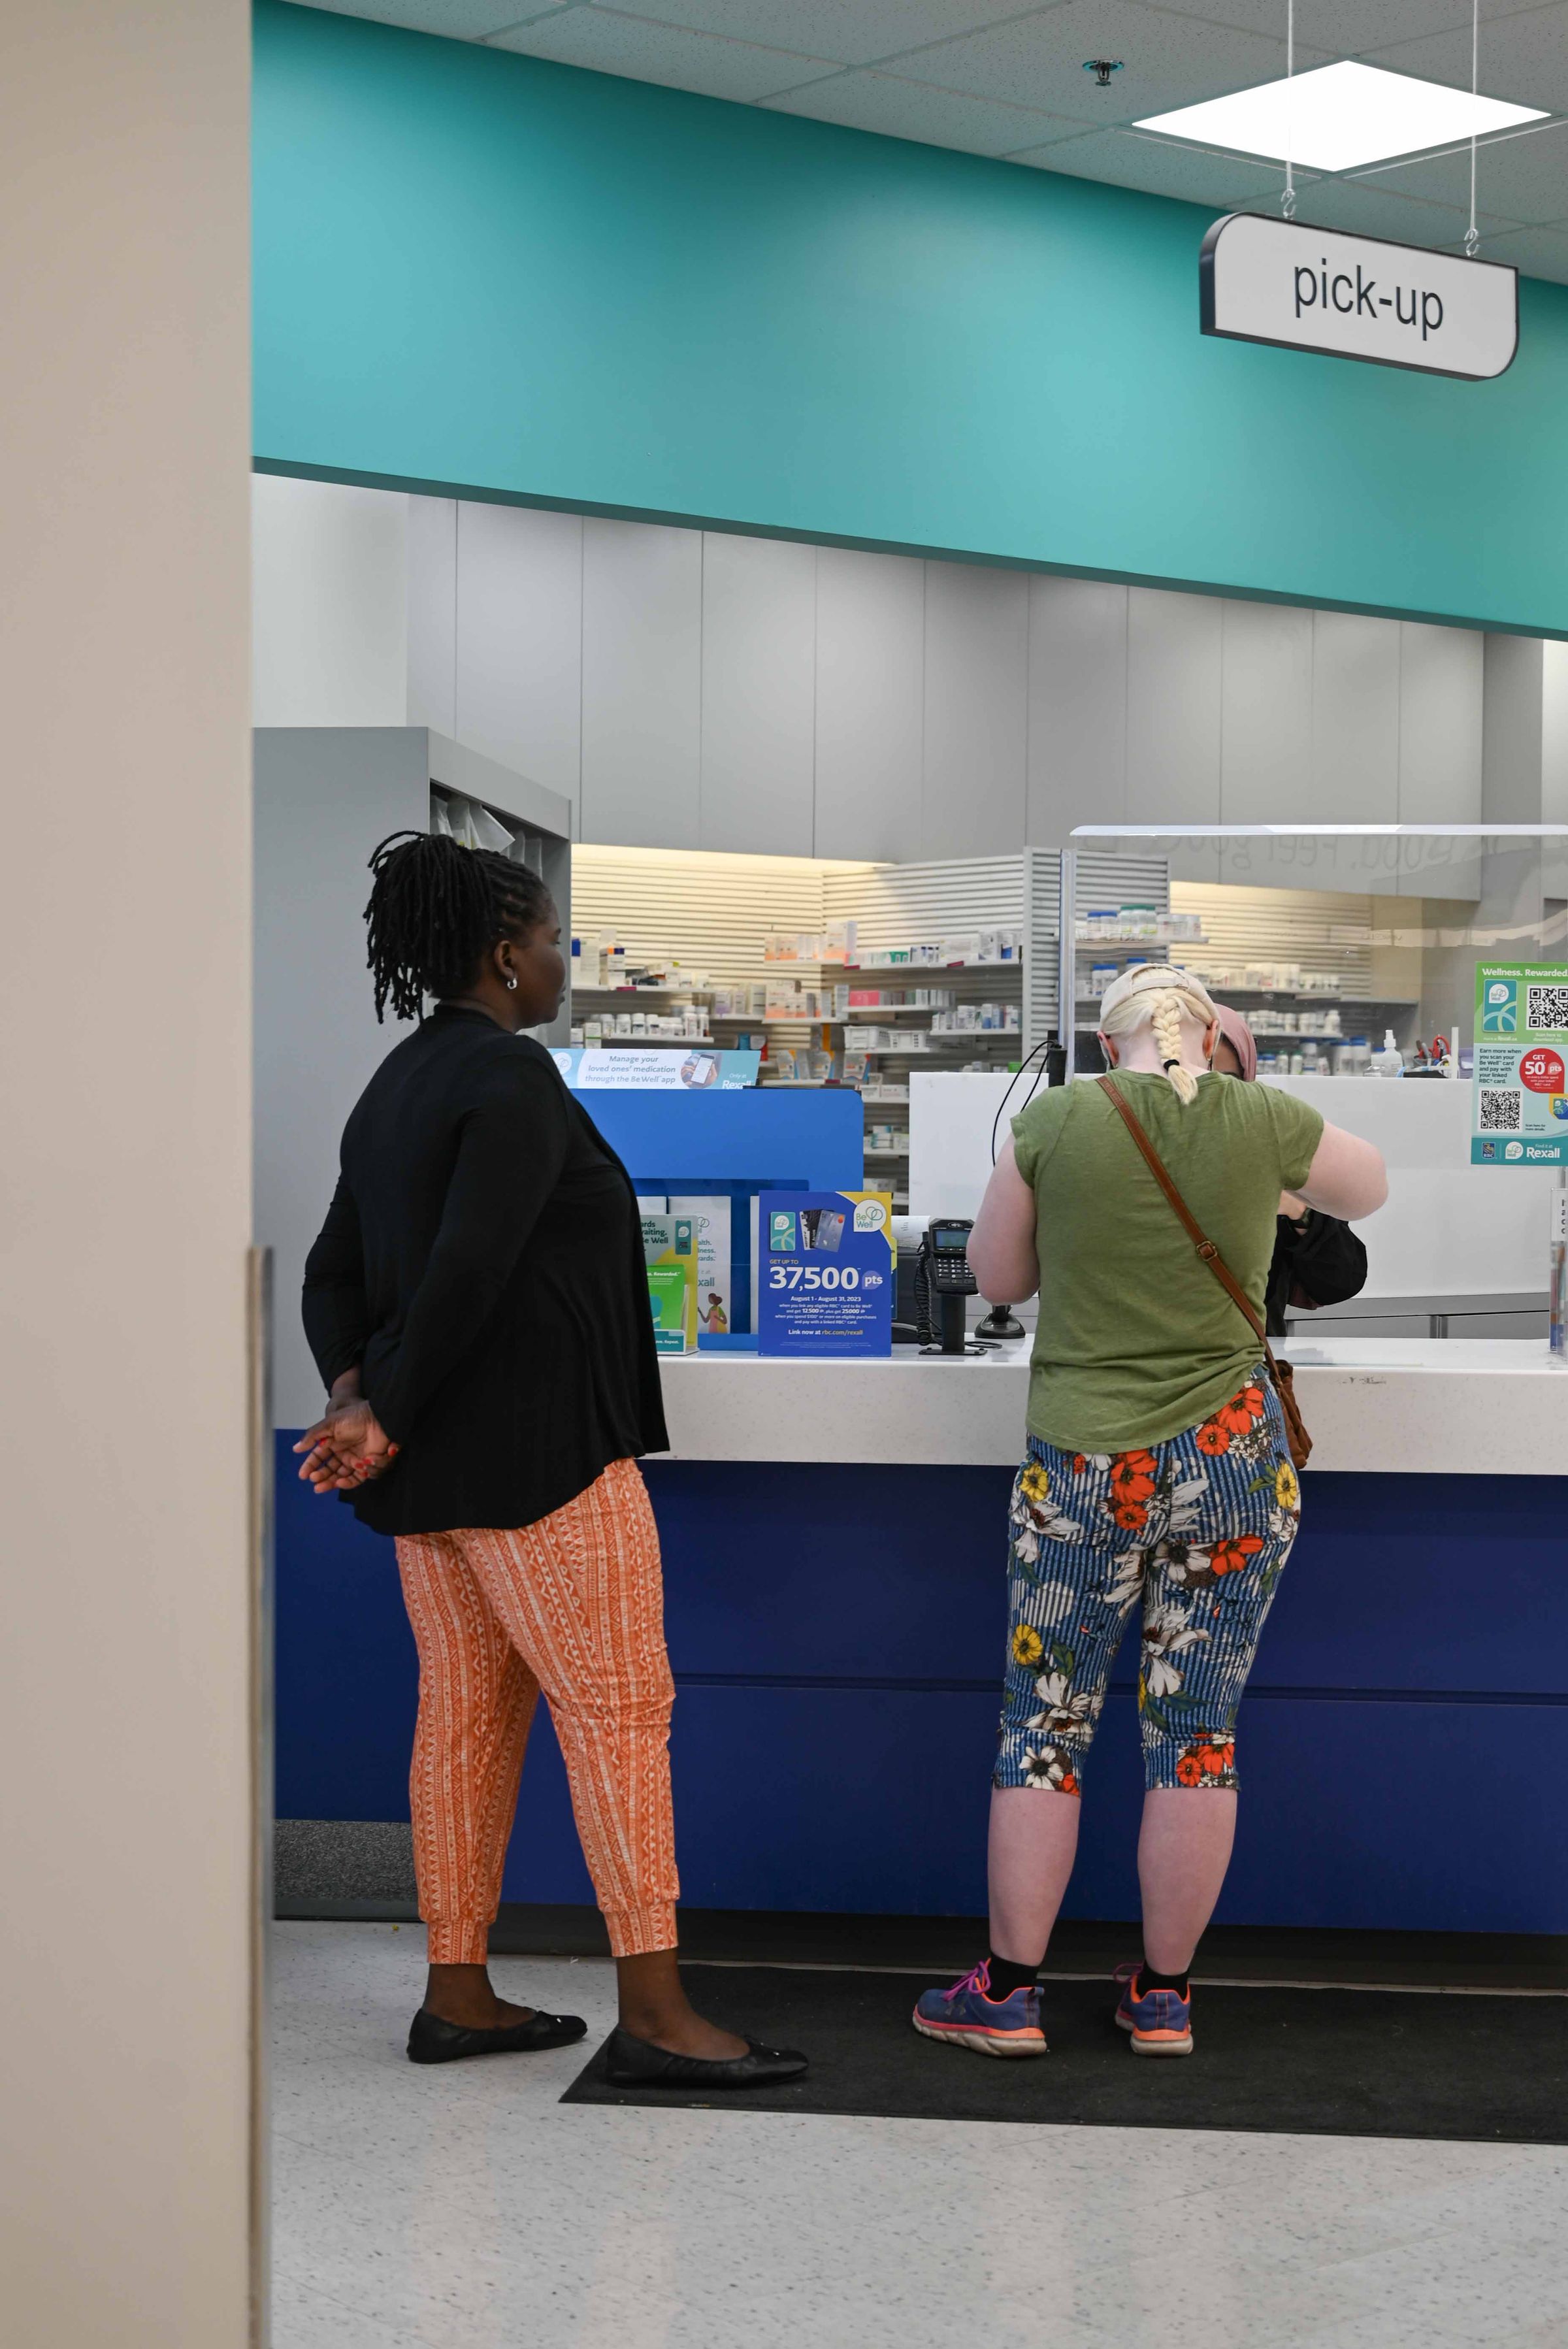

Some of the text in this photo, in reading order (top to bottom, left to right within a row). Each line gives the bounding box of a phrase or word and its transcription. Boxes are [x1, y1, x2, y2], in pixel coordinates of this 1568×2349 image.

[1294, 258, 1443, 341] pick-up
[609, 1056, 659, 1064] Manage your
[1526, 1147, 1560, 1158] Rexall
[769, 1266, 883, 1292] 37,500 pts
